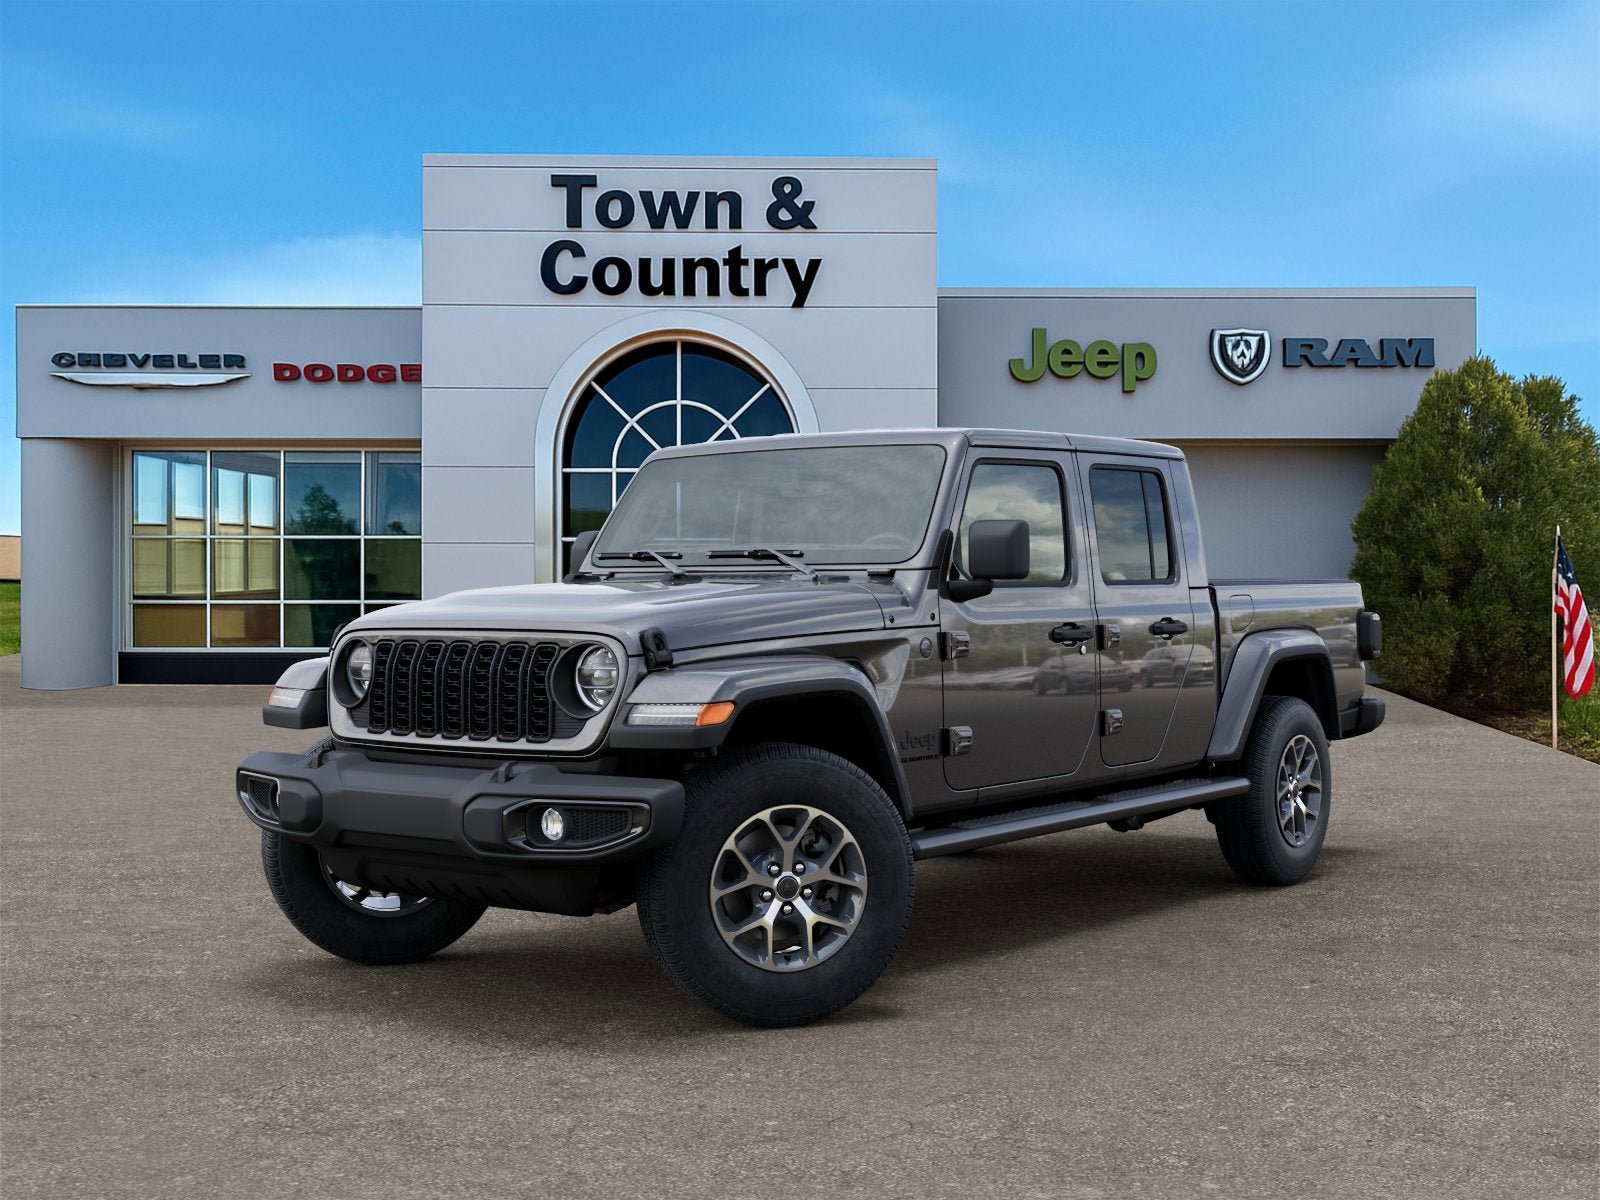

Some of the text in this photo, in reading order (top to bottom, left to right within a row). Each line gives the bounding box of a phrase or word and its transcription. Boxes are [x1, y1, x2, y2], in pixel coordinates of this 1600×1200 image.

[550, 174, 818, 230] Town &
[540, 239, 822, 308] Country
[273, 362, 421, 383] DODGE
[1008, 328, 1157, 393] Jeep
[1283, 338, 1435, 368] RAM
[900, 729, 936, 750] Jeep
